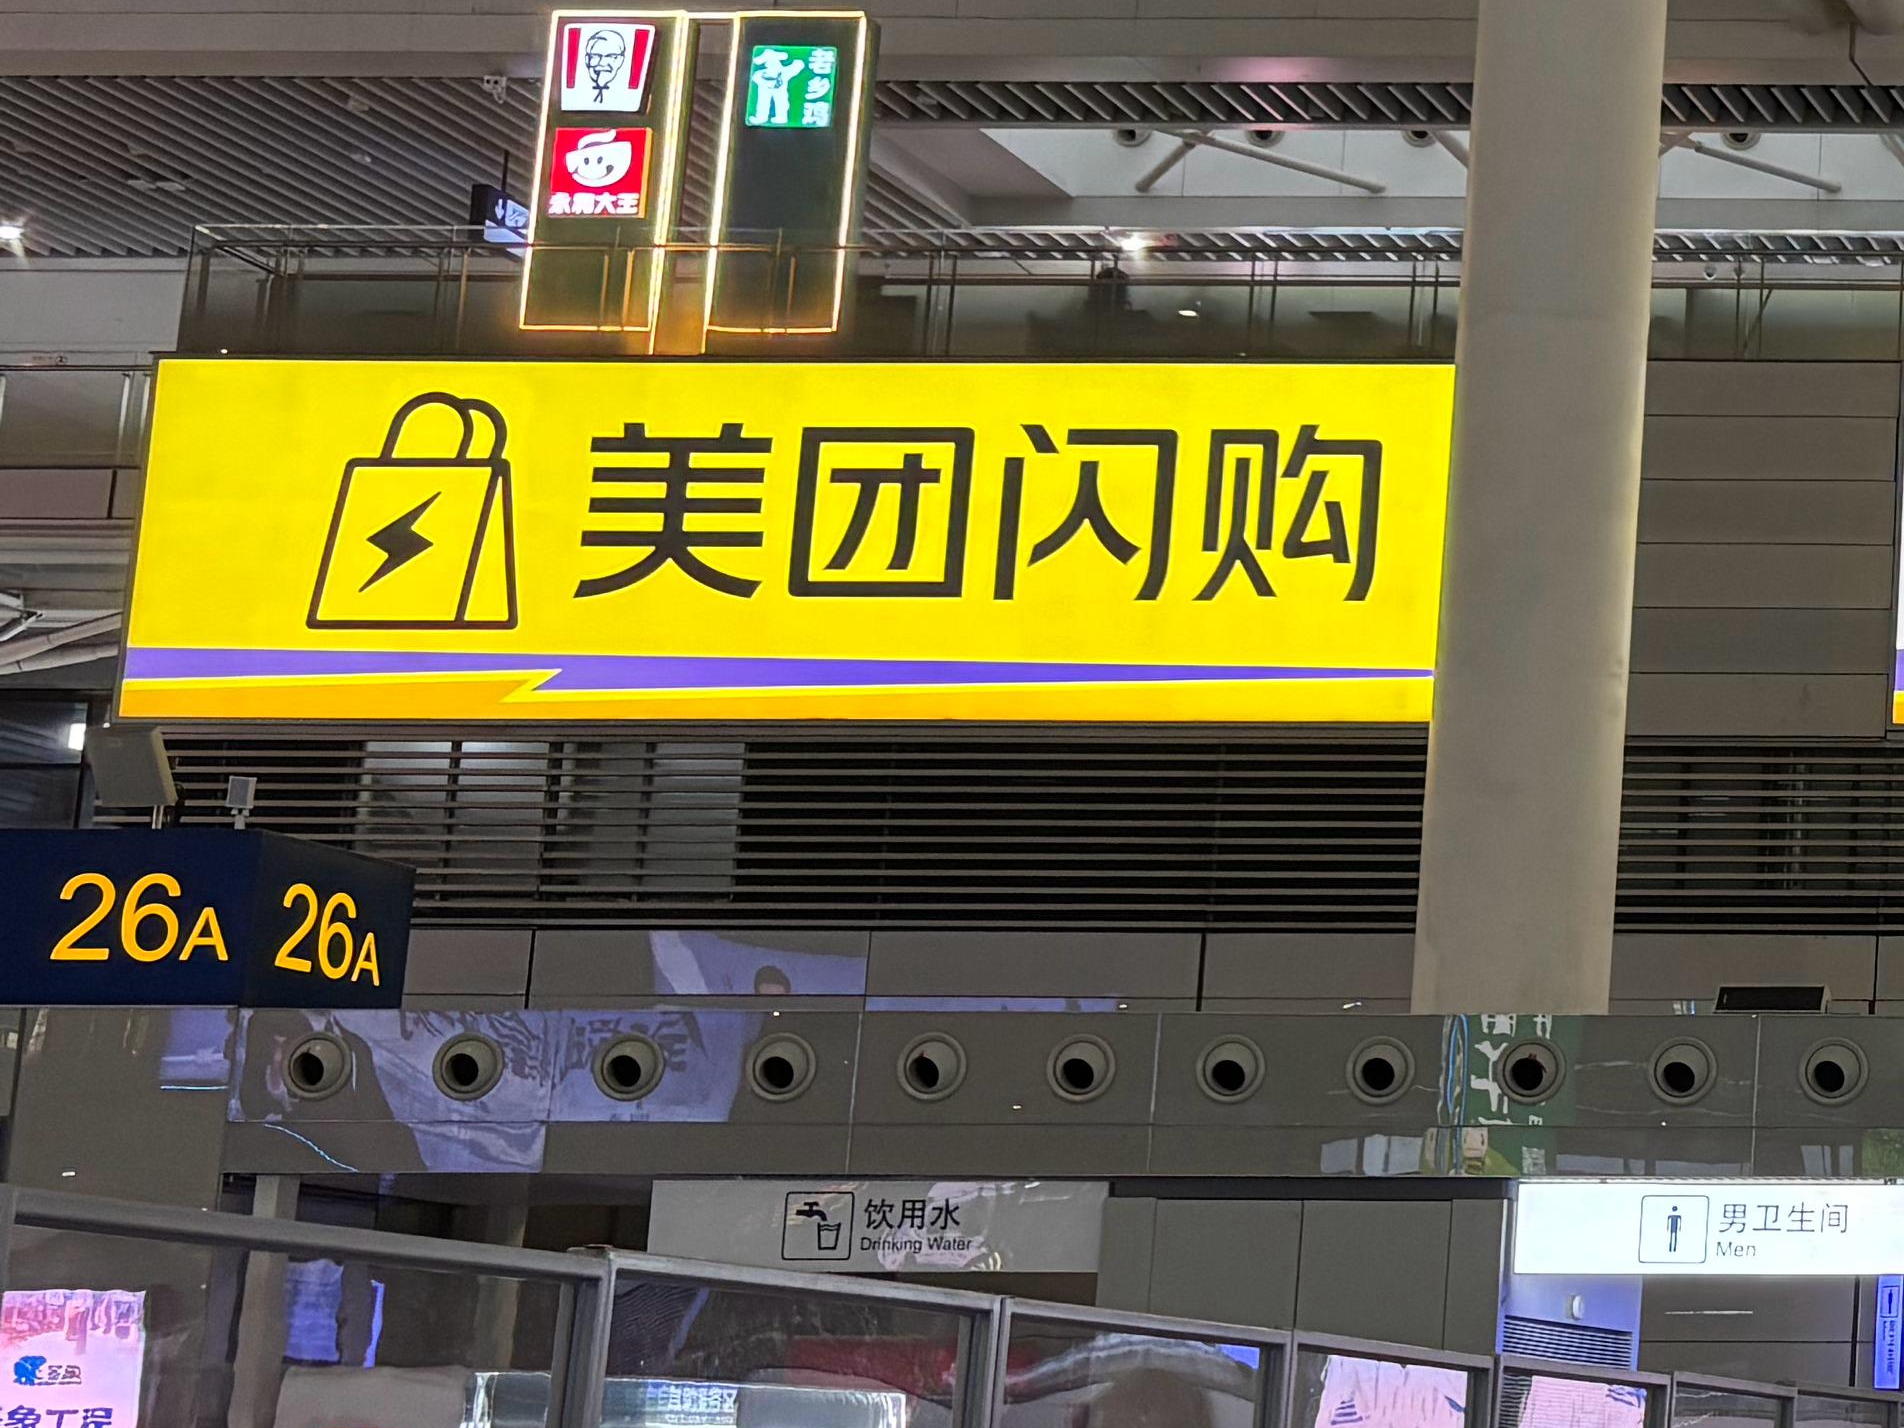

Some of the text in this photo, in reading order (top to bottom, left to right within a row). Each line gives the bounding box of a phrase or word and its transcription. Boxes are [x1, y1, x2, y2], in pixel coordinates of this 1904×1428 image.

[802, 49, 835, 127] 老乡鸡
[574, 422, 1381, 602] 美团闪购
[49, 872, 229, 963] 26A
[274, 882, 381, 987] 26A
[863, 1197, 961, 1231] 饮用水
[1716, 1201, 1849, 1235] 男卫生间
[860, 1235, 973, 1256] Drinking Water
[1715, 1239, 1757, 1260] Men
